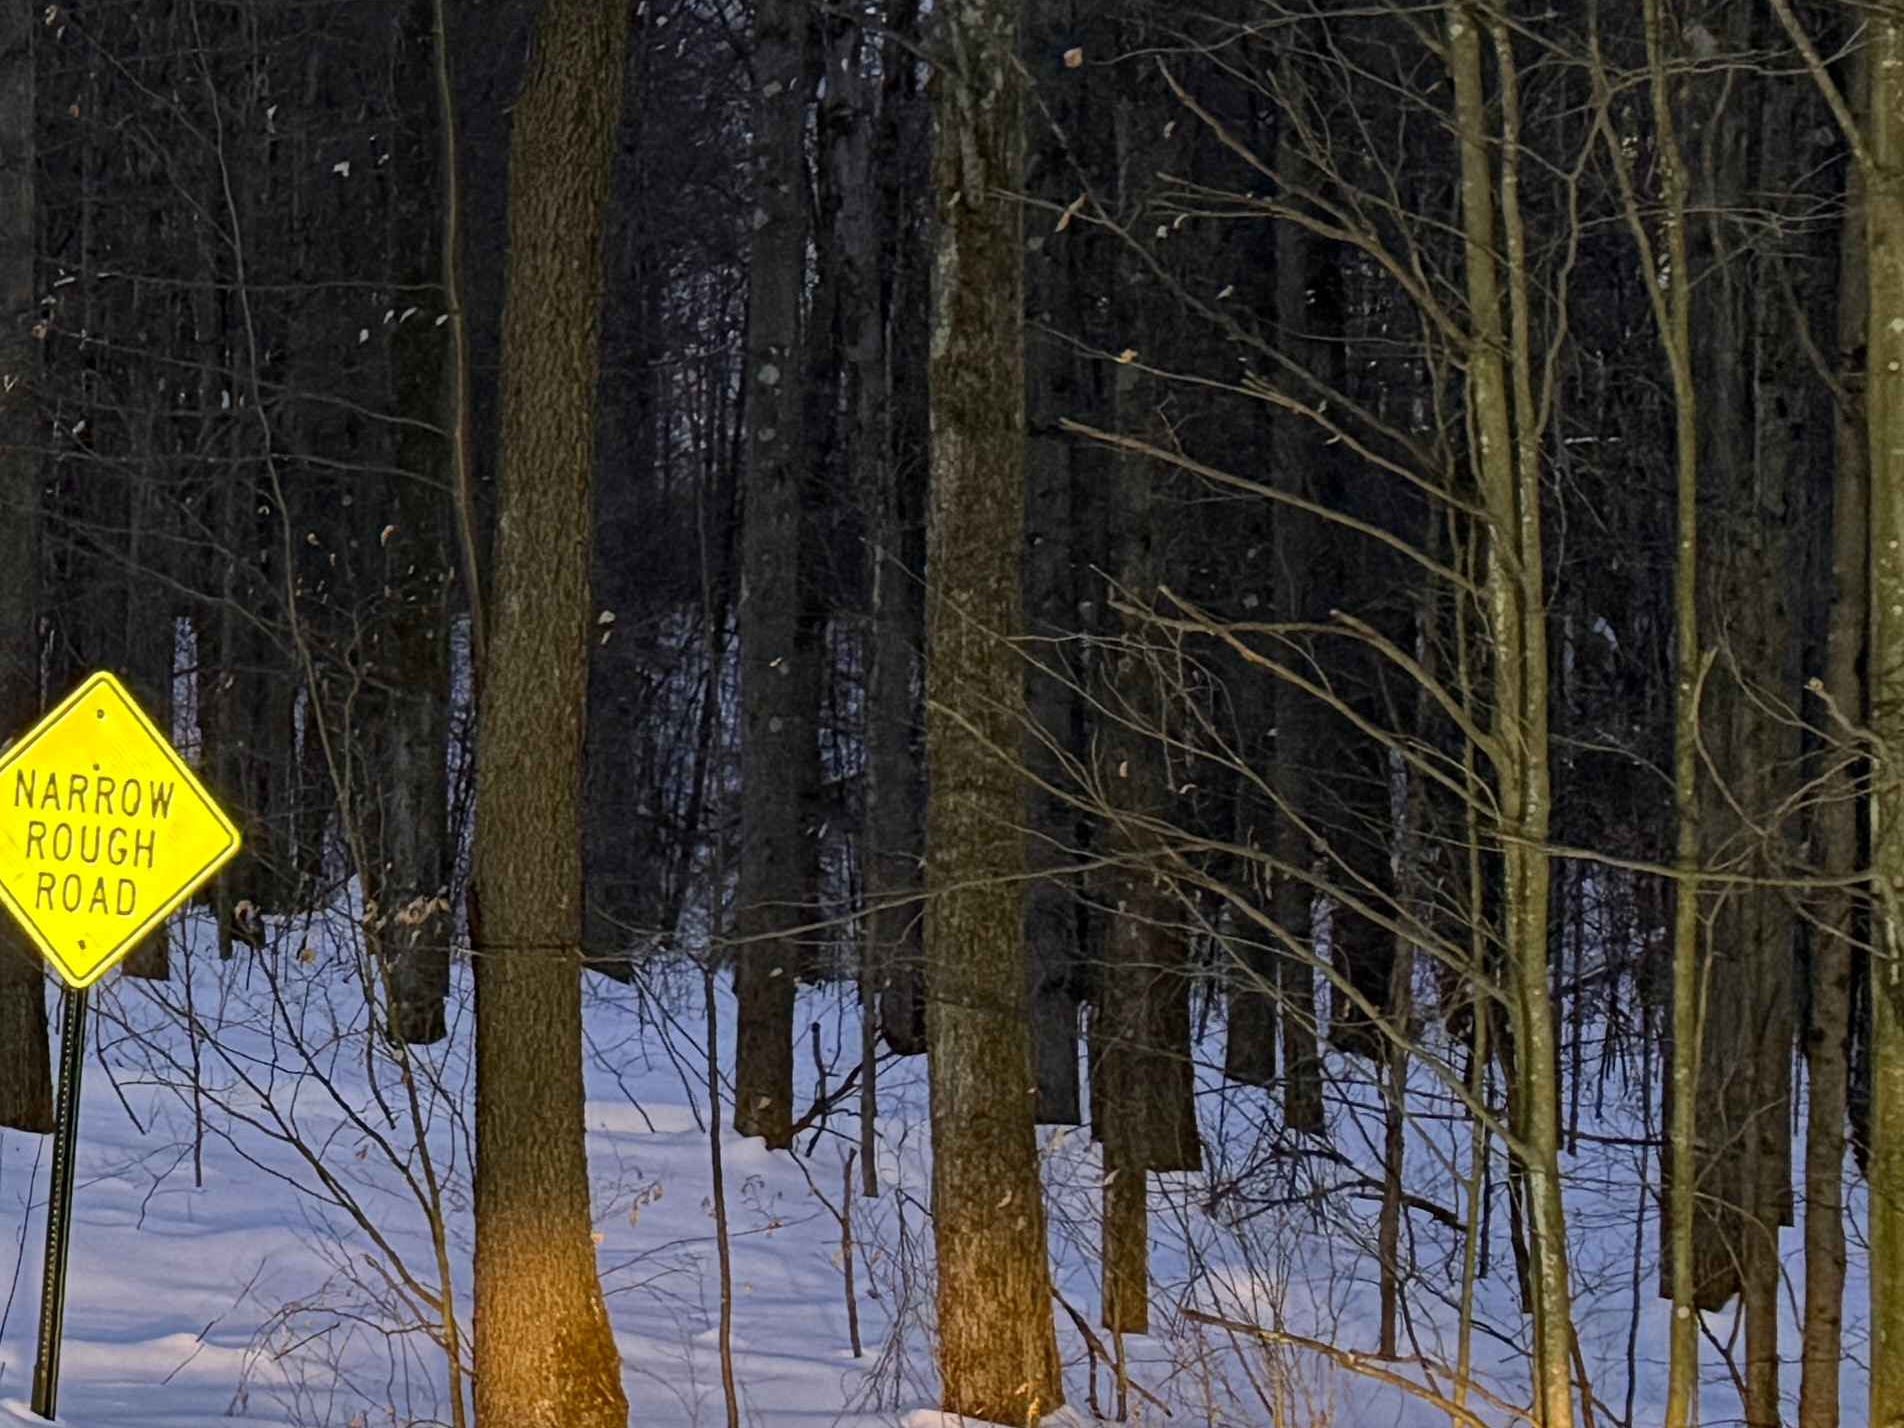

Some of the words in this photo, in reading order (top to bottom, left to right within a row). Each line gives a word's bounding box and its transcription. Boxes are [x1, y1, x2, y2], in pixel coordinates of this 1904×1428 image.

[14, 769, 174, 818] NARROW
[26, 821, 155, 868] ROUGH
[36, 872, 136, 916] ROAD
